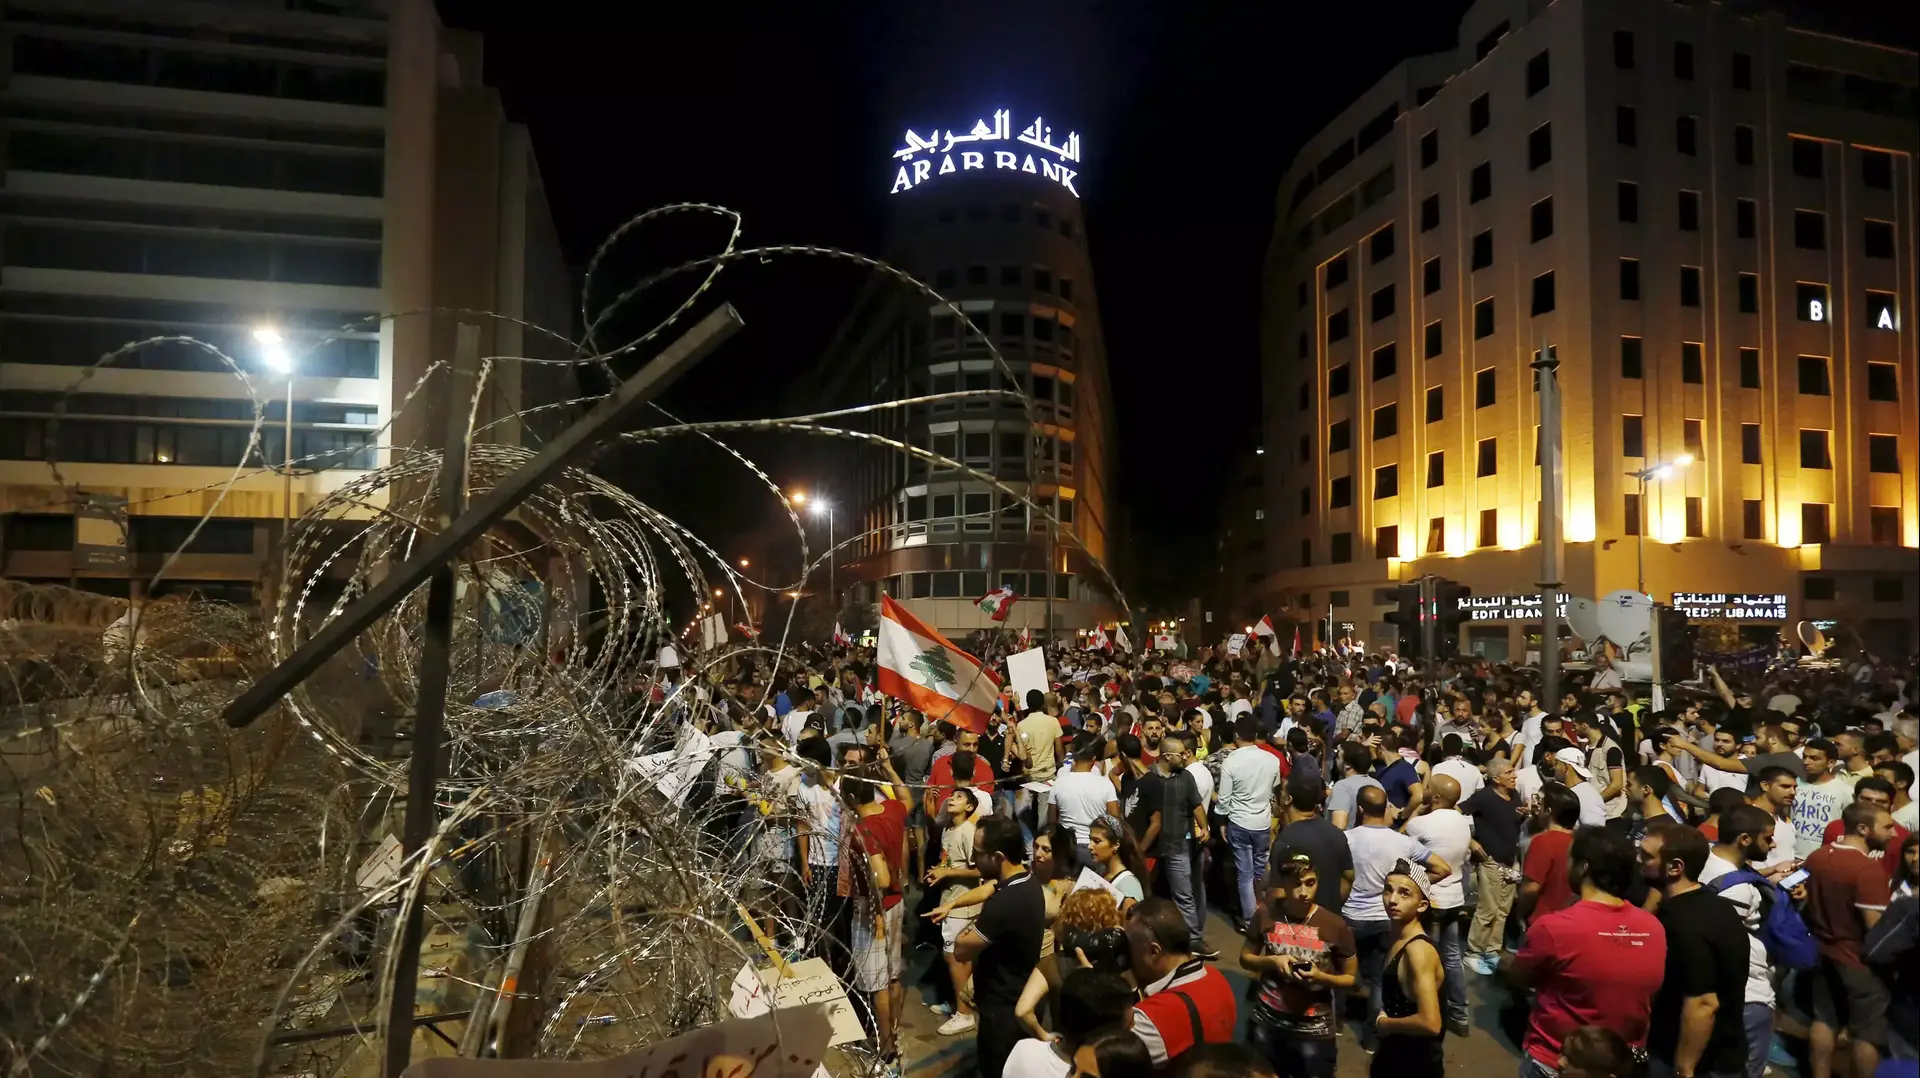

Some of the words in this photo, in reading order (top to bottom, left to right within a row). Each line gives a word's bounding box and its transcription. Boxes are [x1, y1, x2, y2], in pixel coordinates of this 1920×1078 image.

[893, 108, 1010, 162] العربي
[1017, 116, 1080, 163] البنك
[890, 151, 985, 194] ARAB
[993, 150, 1080, 198] BANK
[1471, 609, 1500, 620] EDIT
[1503, 606, 1567, 619] LIBANIS
[1674, 607, 1722, 619] REDIT
[1725, 606, 1787, 619] LIBANAIS
[1733, 594, 1786, 606] الاعتماد
